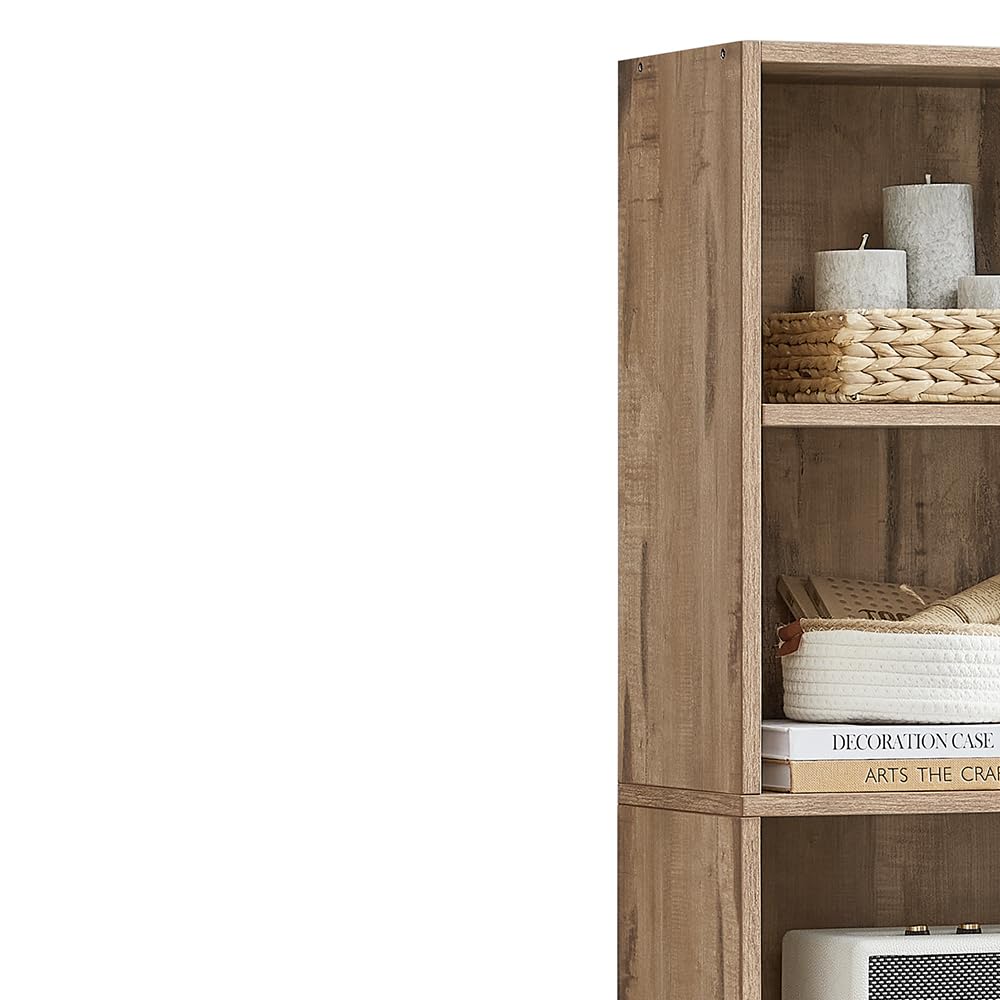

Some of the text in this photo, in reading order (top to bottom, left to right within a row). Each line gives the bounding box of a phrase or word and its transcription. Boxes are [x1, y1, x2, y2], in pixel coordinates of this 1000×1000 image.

[832, 733, 948, 750] DECORATION
[951, 732, 994, 749] CASE
[864, 767, 908, 783] ARTS
[917, 767, 952, 782] THE
